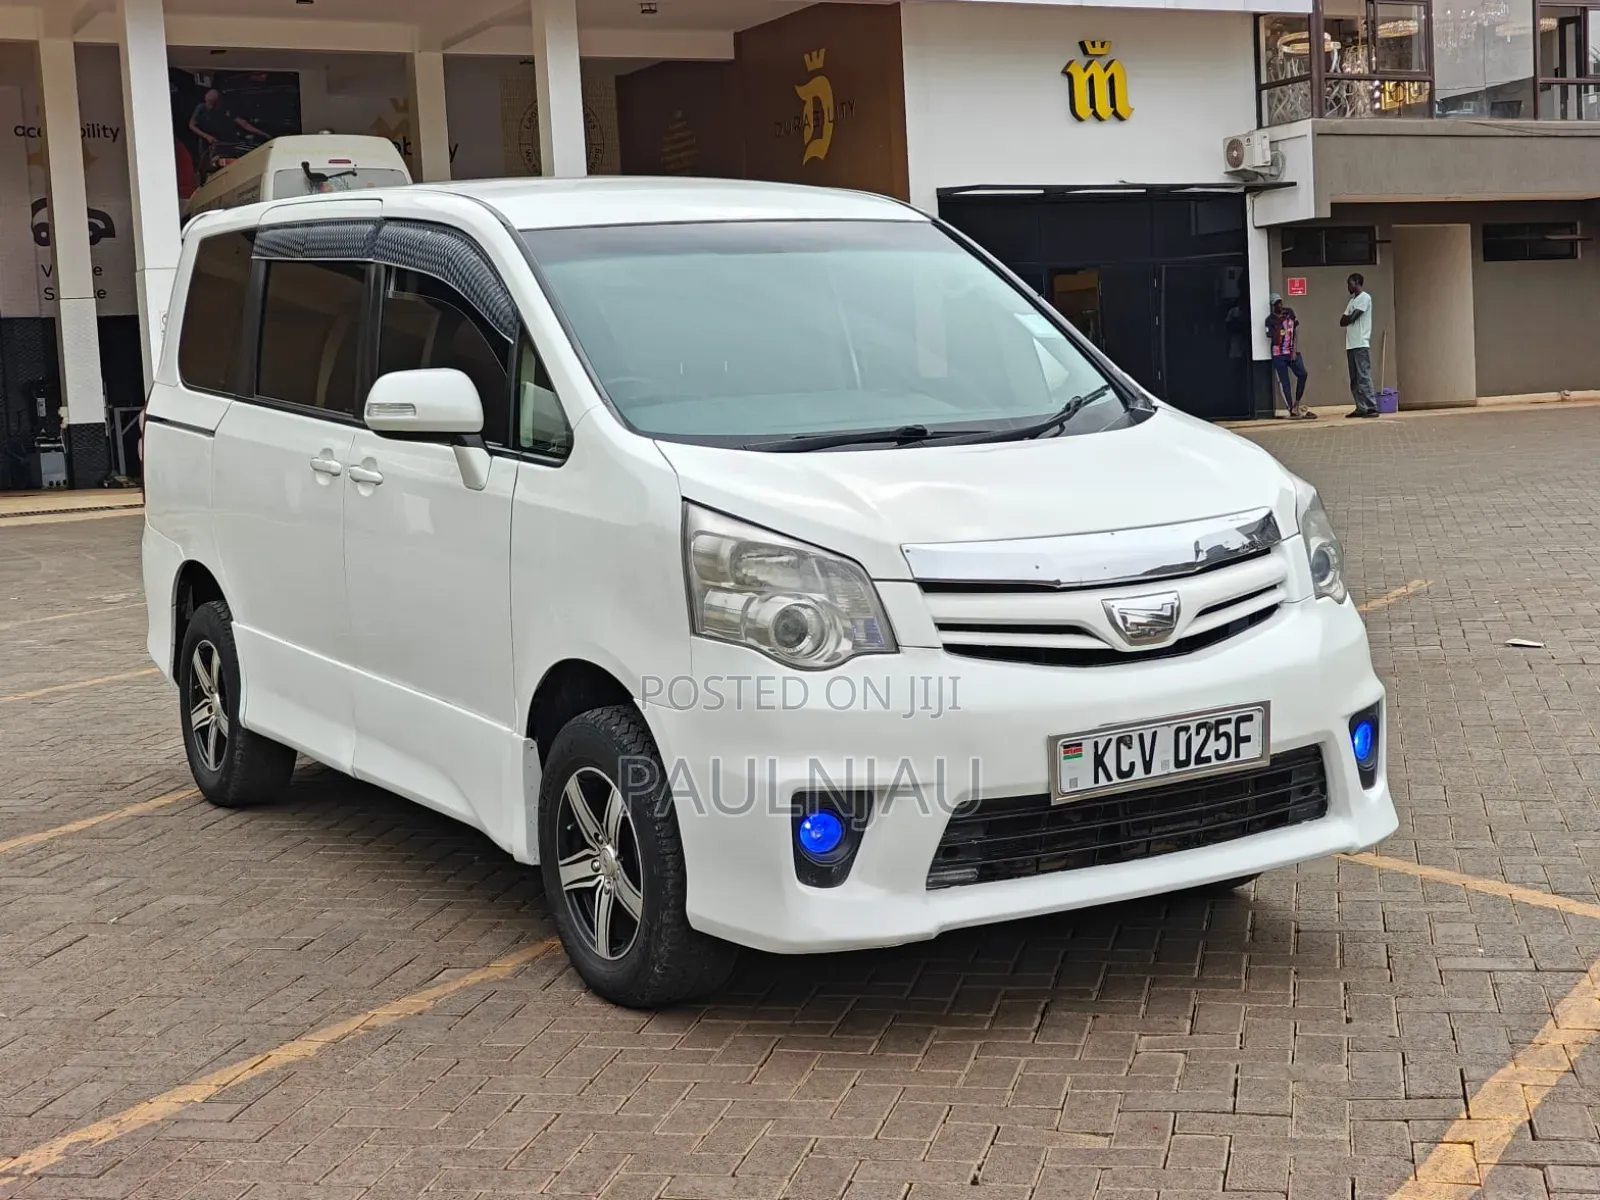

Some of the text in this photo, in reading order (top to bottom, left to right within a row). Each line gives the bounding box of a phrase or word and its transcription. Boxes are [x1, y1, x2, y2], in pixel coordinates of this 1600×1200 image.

[13, 123, 120, 143] acility
[1093, 714, 1254, 784] KCV 025F
